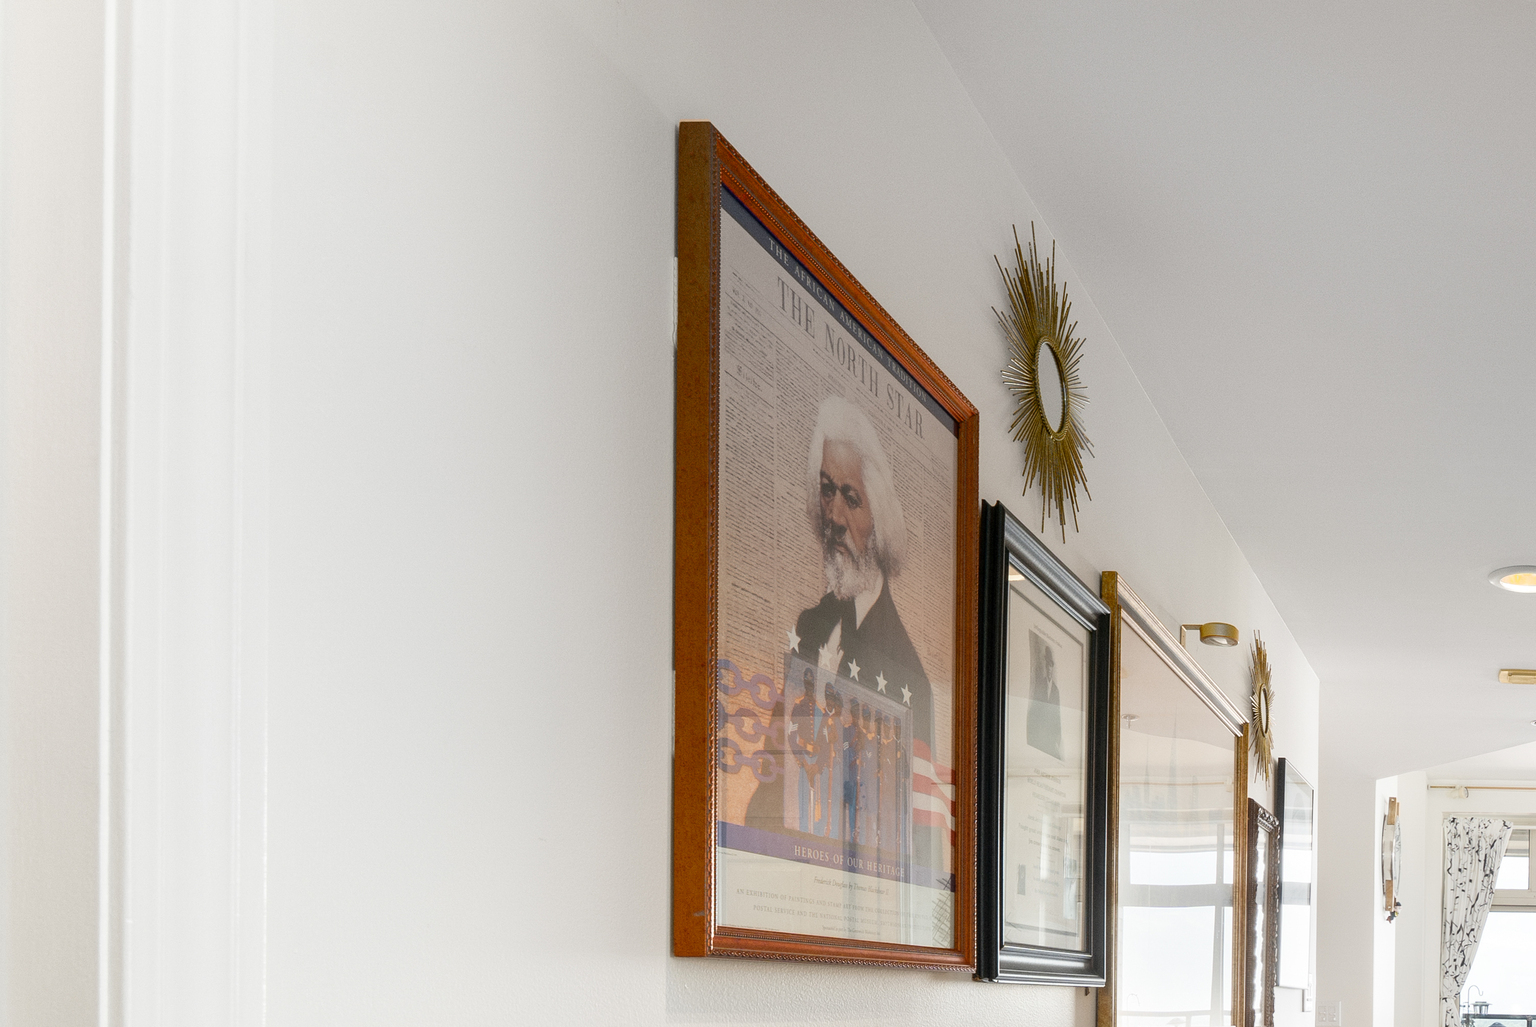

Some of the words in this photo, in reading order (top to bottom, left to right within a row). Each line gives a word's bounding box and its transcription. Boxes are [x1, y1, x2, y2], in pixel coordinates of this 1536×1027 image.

[768, 237, 789, 266] THE
[794, 265, 836, 312] AFRICAN
[839, 310, 884, 360] AMERICAN
[886, 356, 928, 403] TRADITION
[777, 275, 815, 339] THE
[824, 320, 879, 399] NORTH
[746, 889, 779, 900] EXHIBITION
[794, 844, 830, 863] HEROES
[832, 853, 844, 865] OF
[847, 856, 864, 869] OUR
[866, 861, 905, 878] HERITAGE
